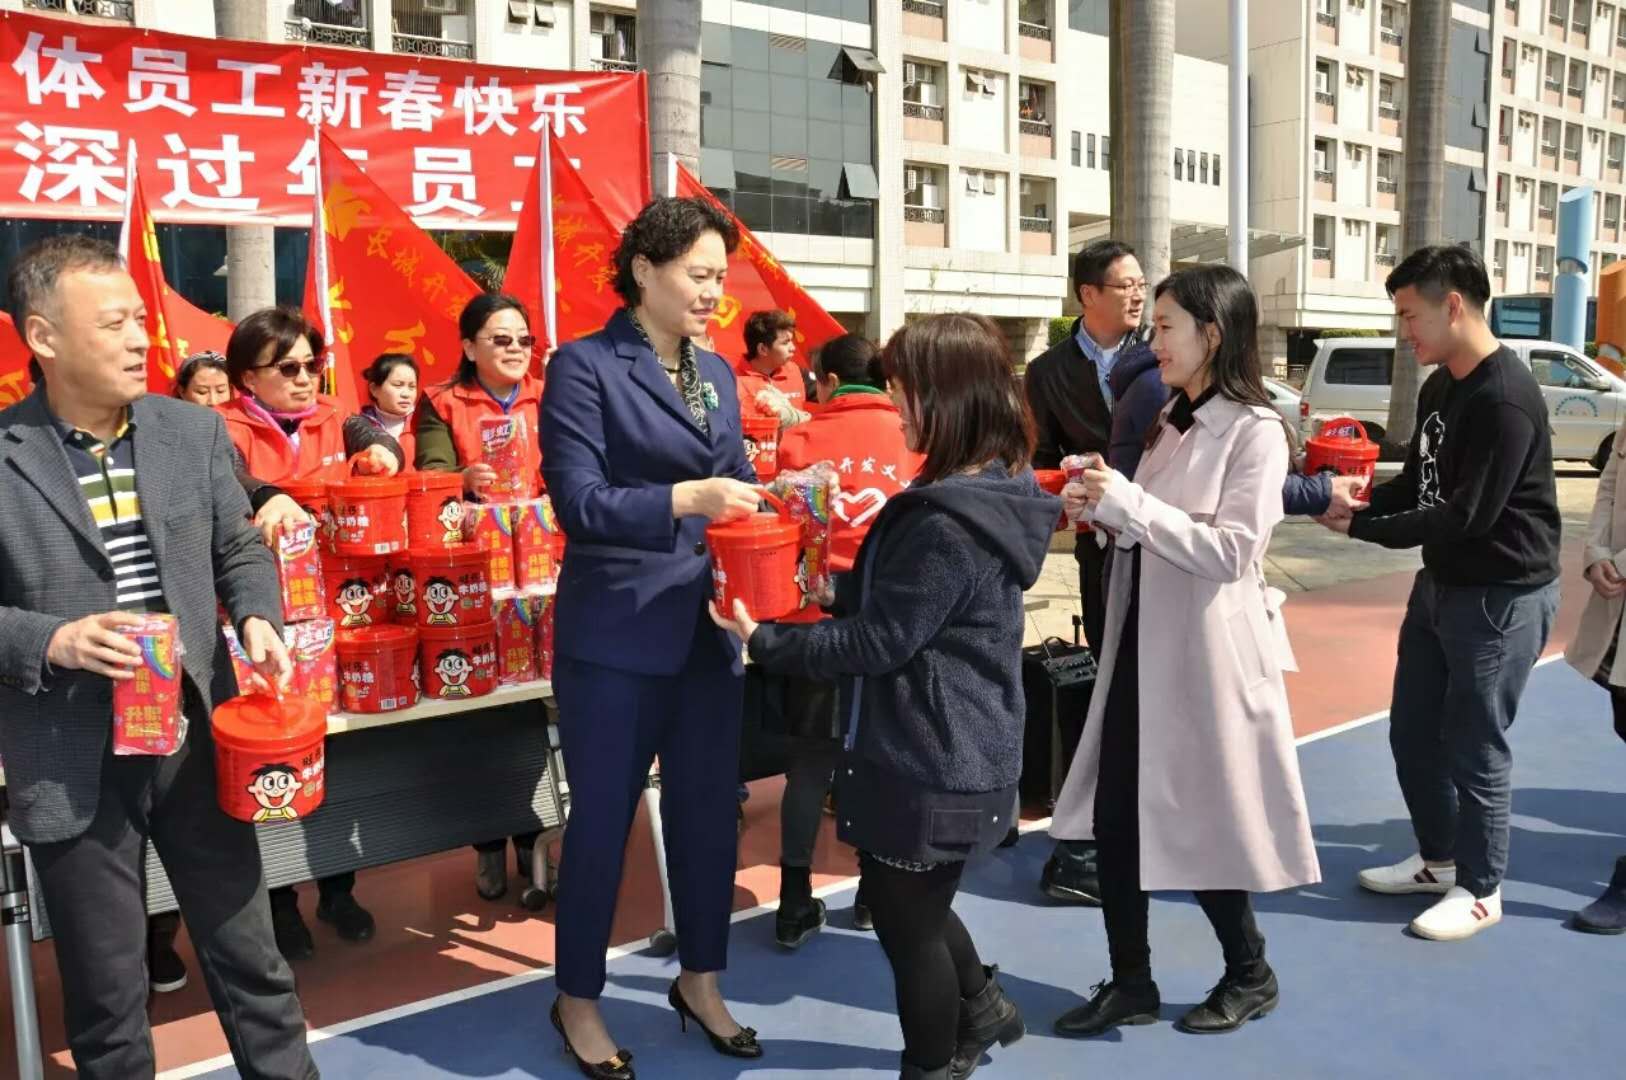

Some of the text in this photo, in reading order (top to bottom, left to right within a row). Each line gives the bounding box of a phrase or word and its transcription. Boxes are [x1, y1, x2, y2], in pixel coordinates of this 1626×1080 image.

[12, 31, 588, 137] 体员工新春快乐
